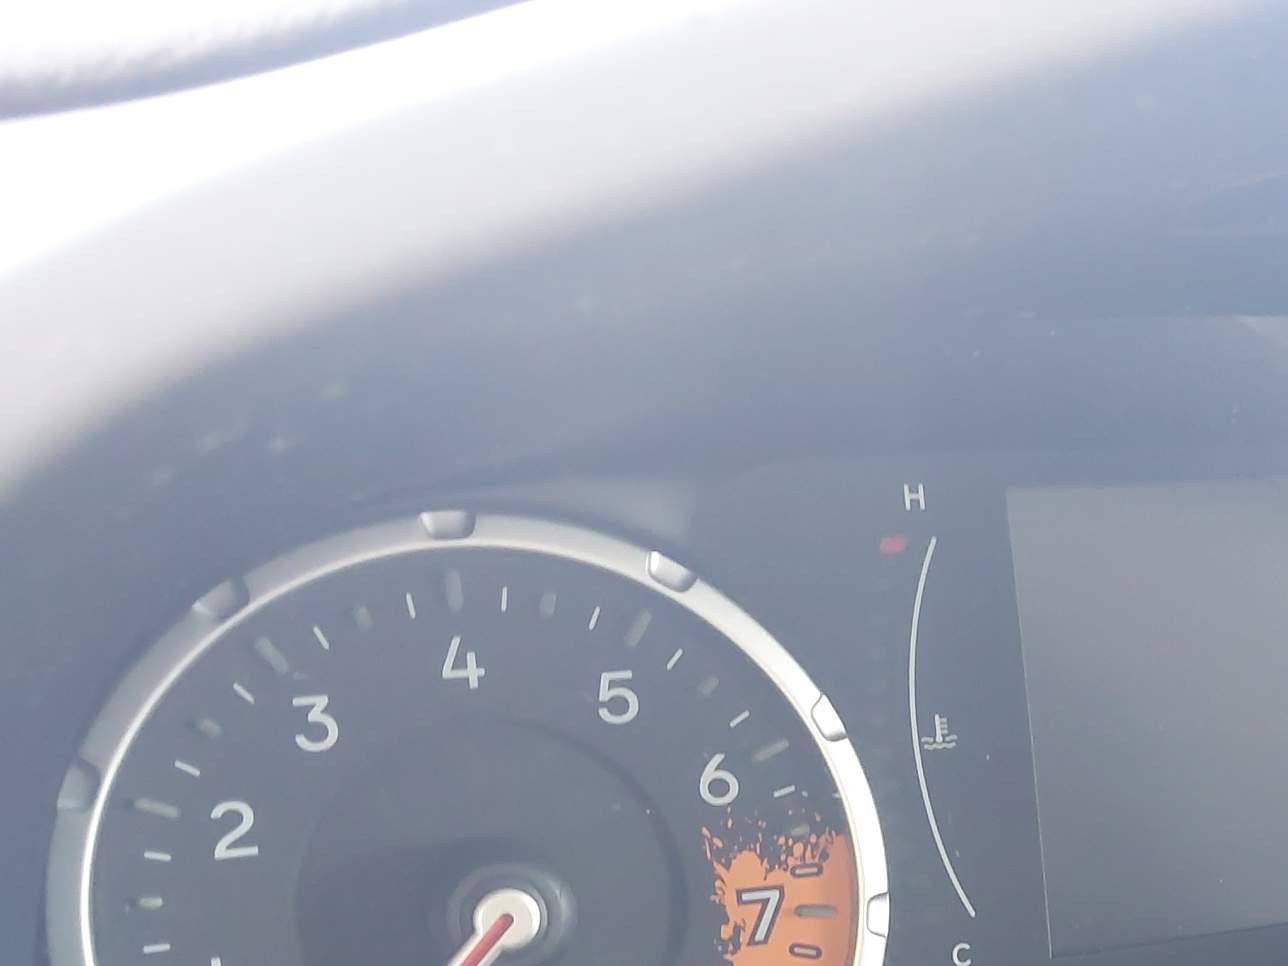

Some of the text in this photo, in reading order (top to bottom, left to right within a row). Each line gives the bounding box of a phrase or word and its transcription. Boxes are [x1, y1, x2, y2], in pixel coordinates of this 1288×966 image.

[903, 483, 926, 511] H
[442, 636, 485, 689] 4
[292, 694, 339, 752] 3
[598, 670, 639, 725] 5
[699, 753, 739, 806] 6
[210, 800, 259, 860] 2
[735, 886, 785, 945] 7
